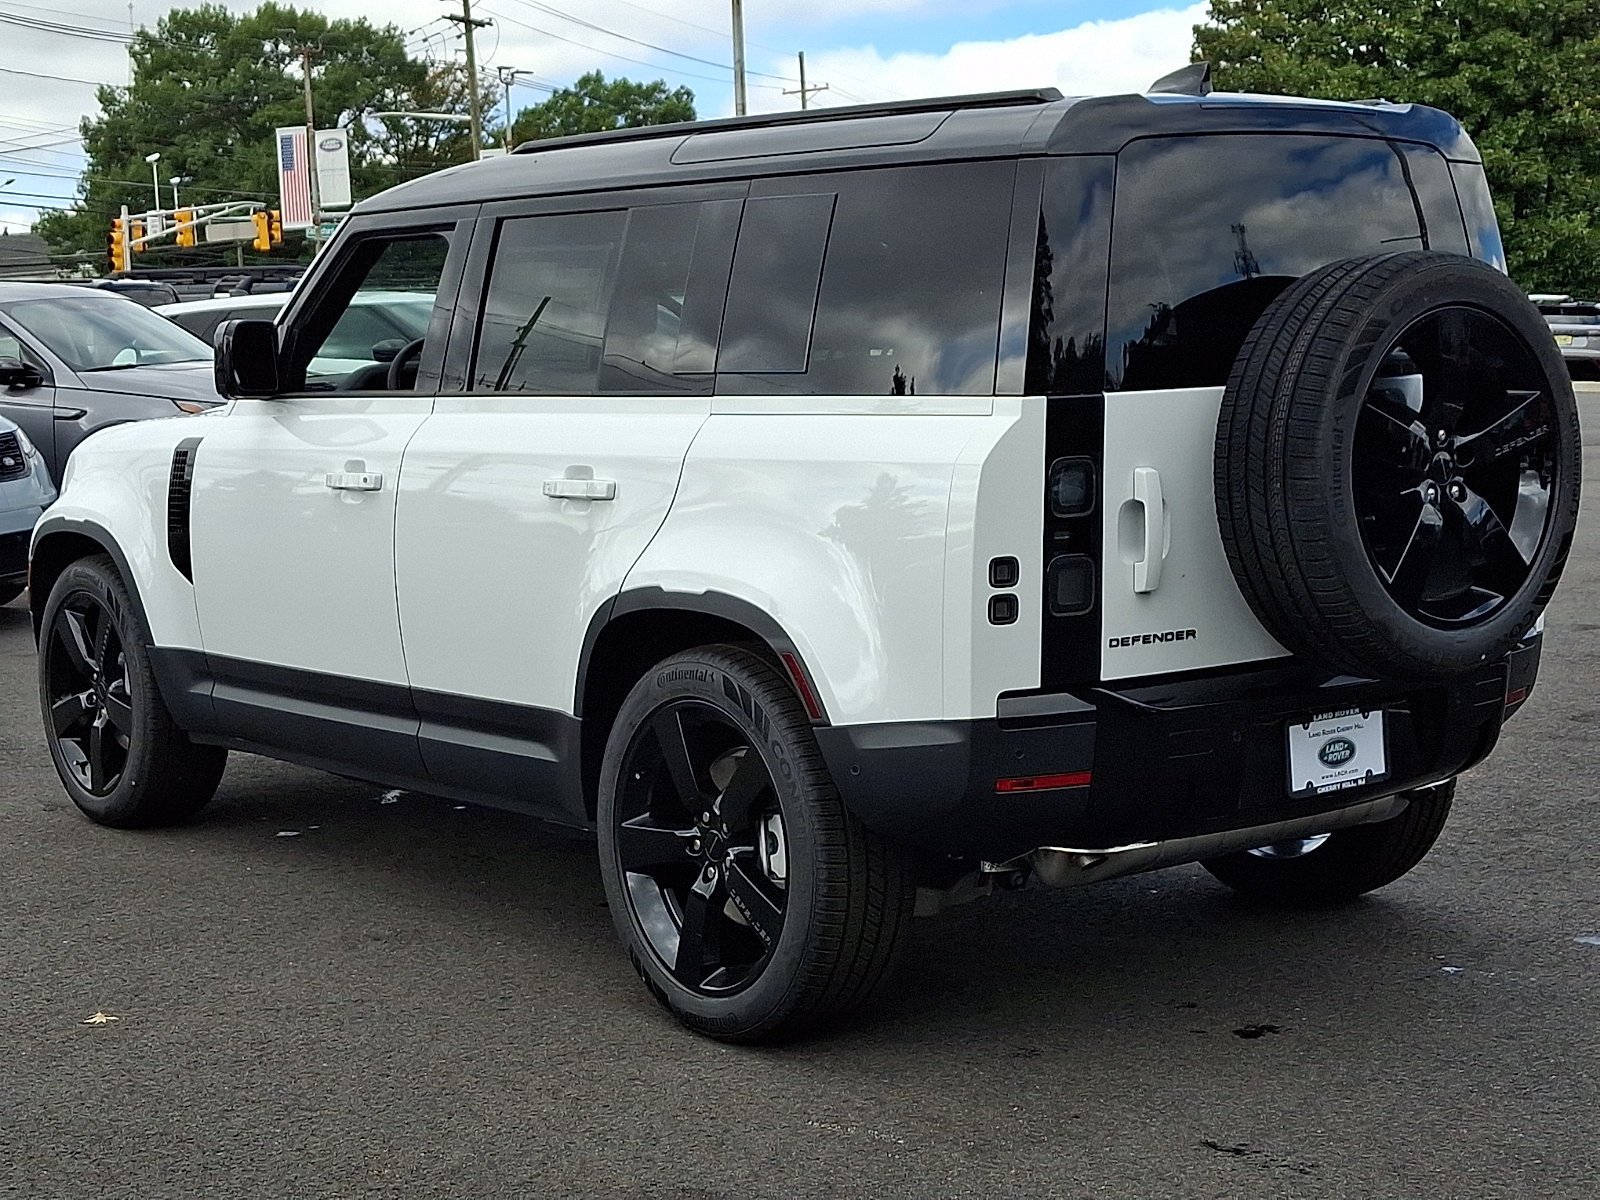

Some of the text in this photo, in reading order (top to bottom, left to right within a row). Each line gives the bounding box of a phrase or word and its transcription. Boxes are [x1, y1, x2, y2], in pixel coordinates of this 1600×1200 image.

[1108, 628, 1197, 649] DEFENDER
[656, 667, 709, 689] Continental
[1313, 708, 1359, 721] LAND ROVER
[1326, 743, 1344, 754] LAND
[1327, 750, 1351, 762] ROVER
